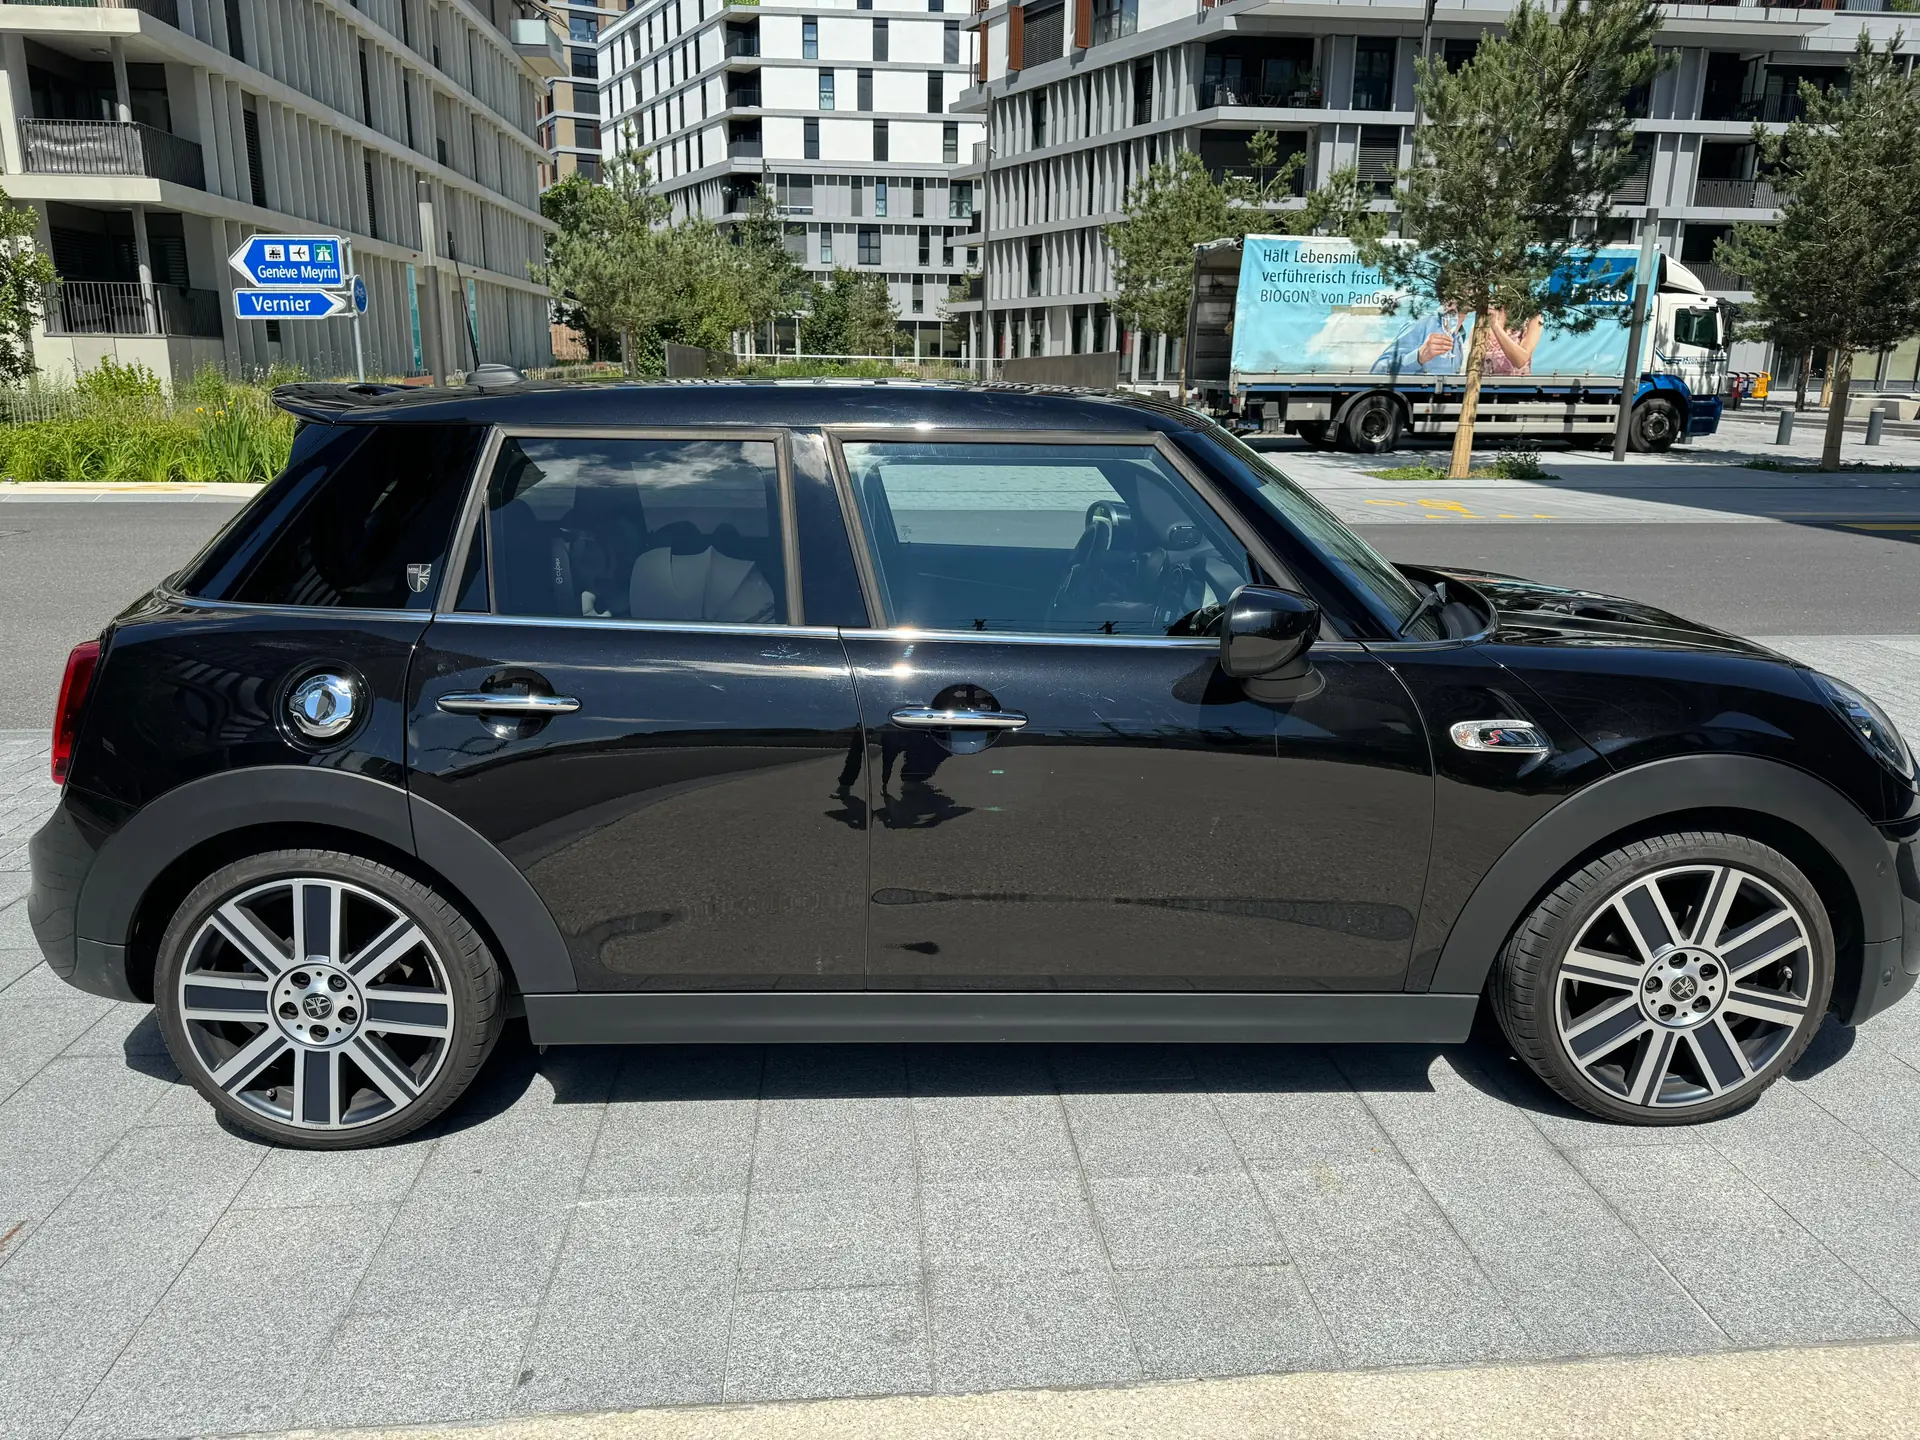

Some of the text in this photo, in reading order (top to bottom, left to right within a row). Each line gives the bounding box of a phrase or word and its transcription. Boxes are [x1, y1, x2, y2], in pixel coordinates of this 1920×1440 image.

[1263, 248, 1361, 264] Hält Lebensmit
[257, 265, 338, 282] Genève Meyrin
[1262, 268, 1385, 285] verführerisch frisch
[252, 296, 311, 312] Vernier
[1321, 293, 1344, 304] von
[554, 557, 563, 577] cybex
